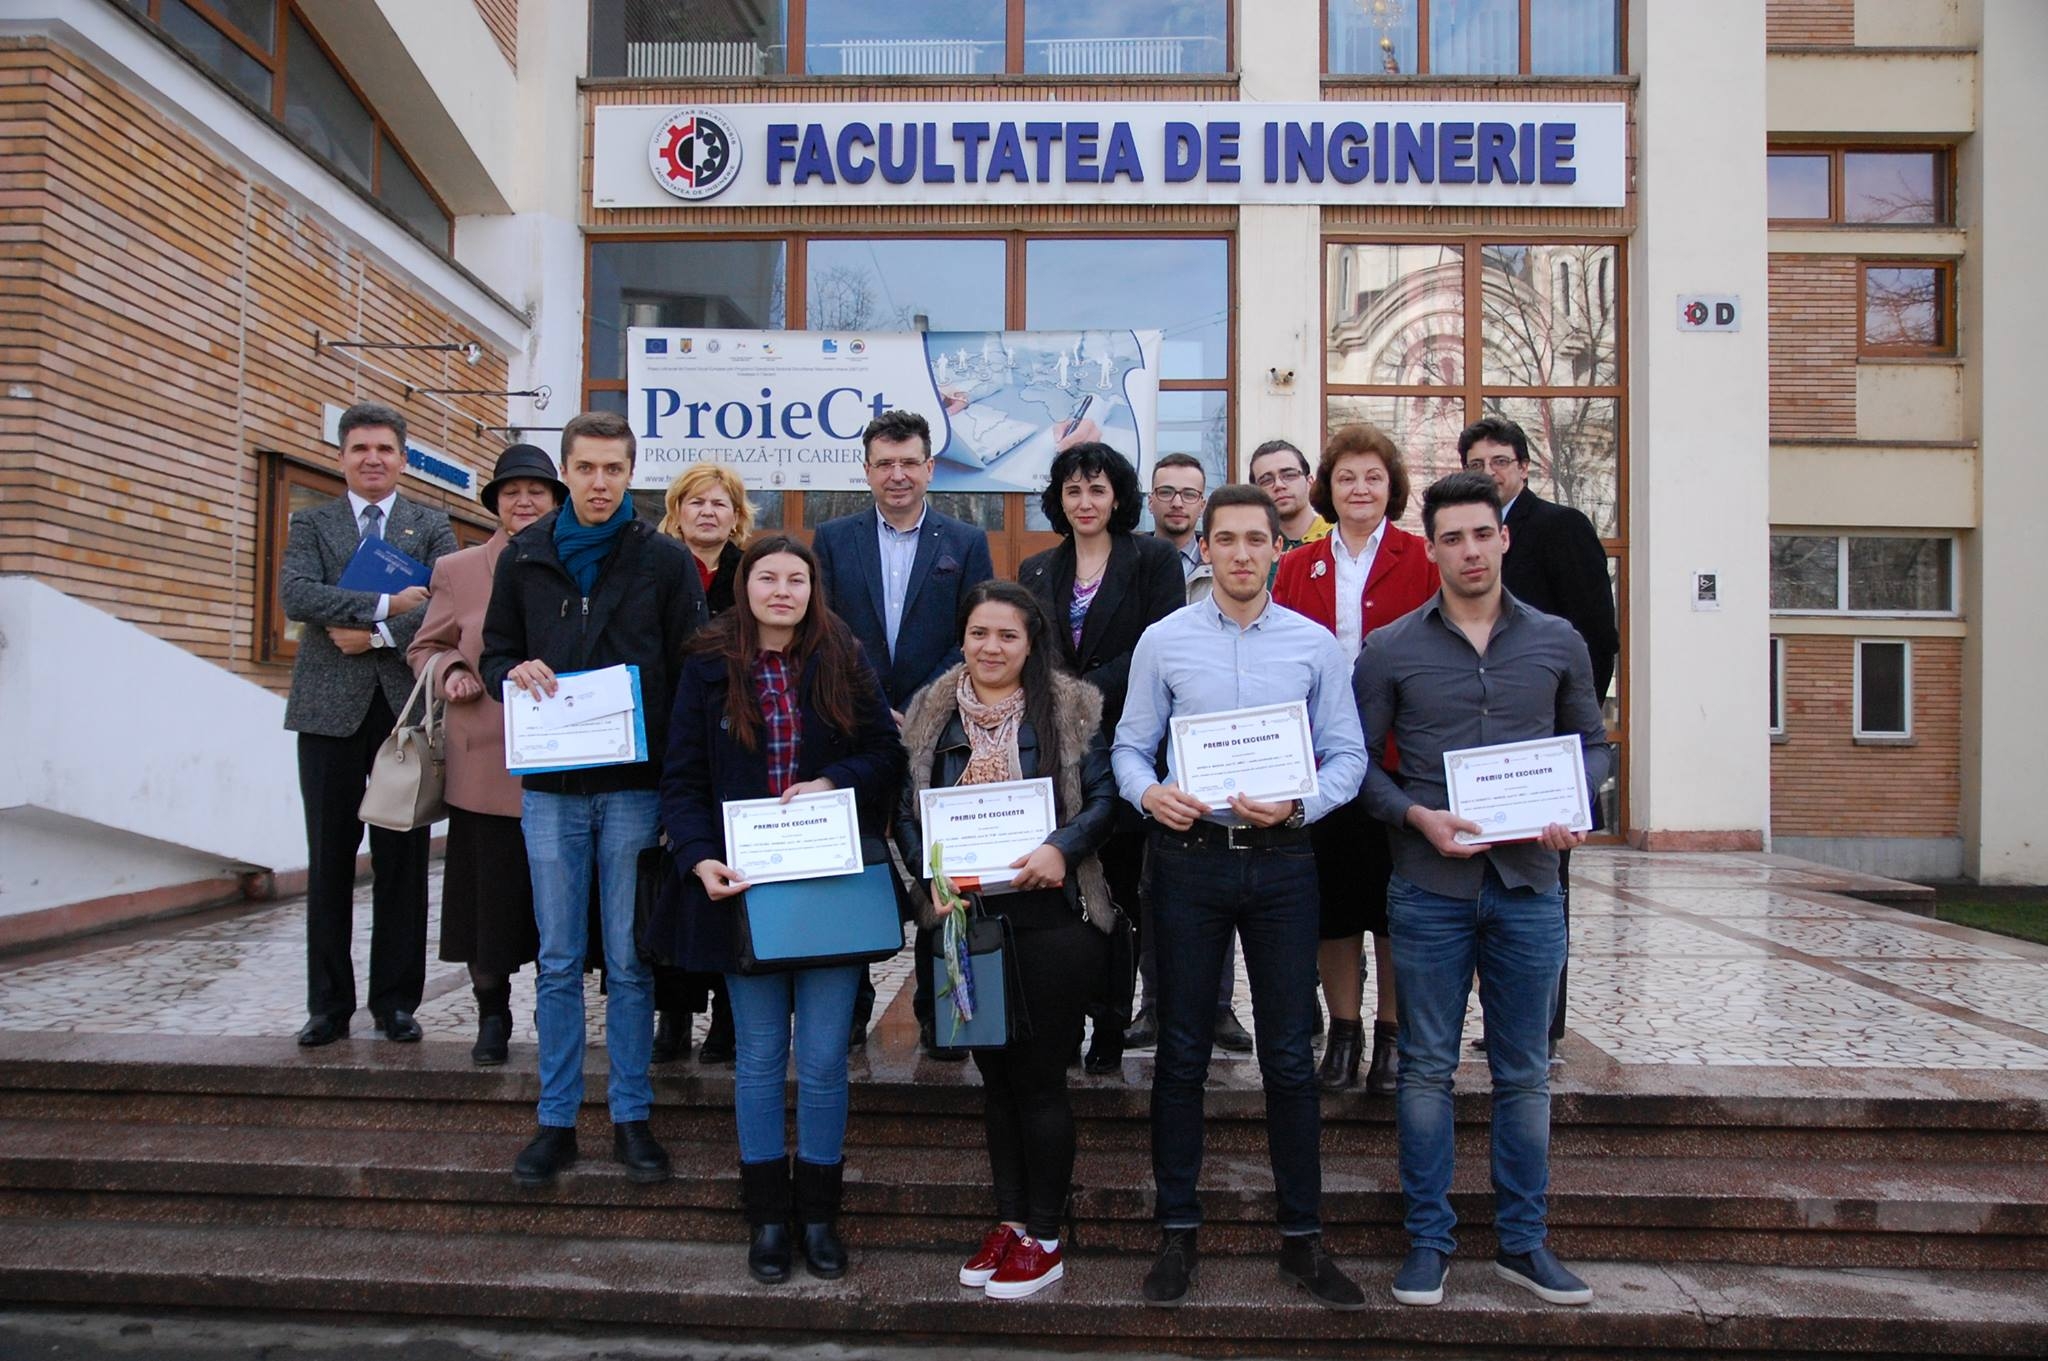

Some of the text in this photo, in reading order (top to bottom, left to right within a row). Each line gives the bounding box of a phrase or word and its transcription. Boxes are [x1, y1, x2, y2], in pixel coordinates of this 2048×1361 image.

[766, 121, 1577, 185] FACULTATEA DE INGINERIE
[1716, 302, 1735, 325] D
[640, 387, 893, 440] ProieCt
[798, 448, 866, 463] CARIER
[1203, 740, 1230, 749] PREMIU
[1476, 774, 1502, 783] PREMIU
[950, 814, 976, 822] PREMIU
[753, 822, 780, 830] PREMIU
